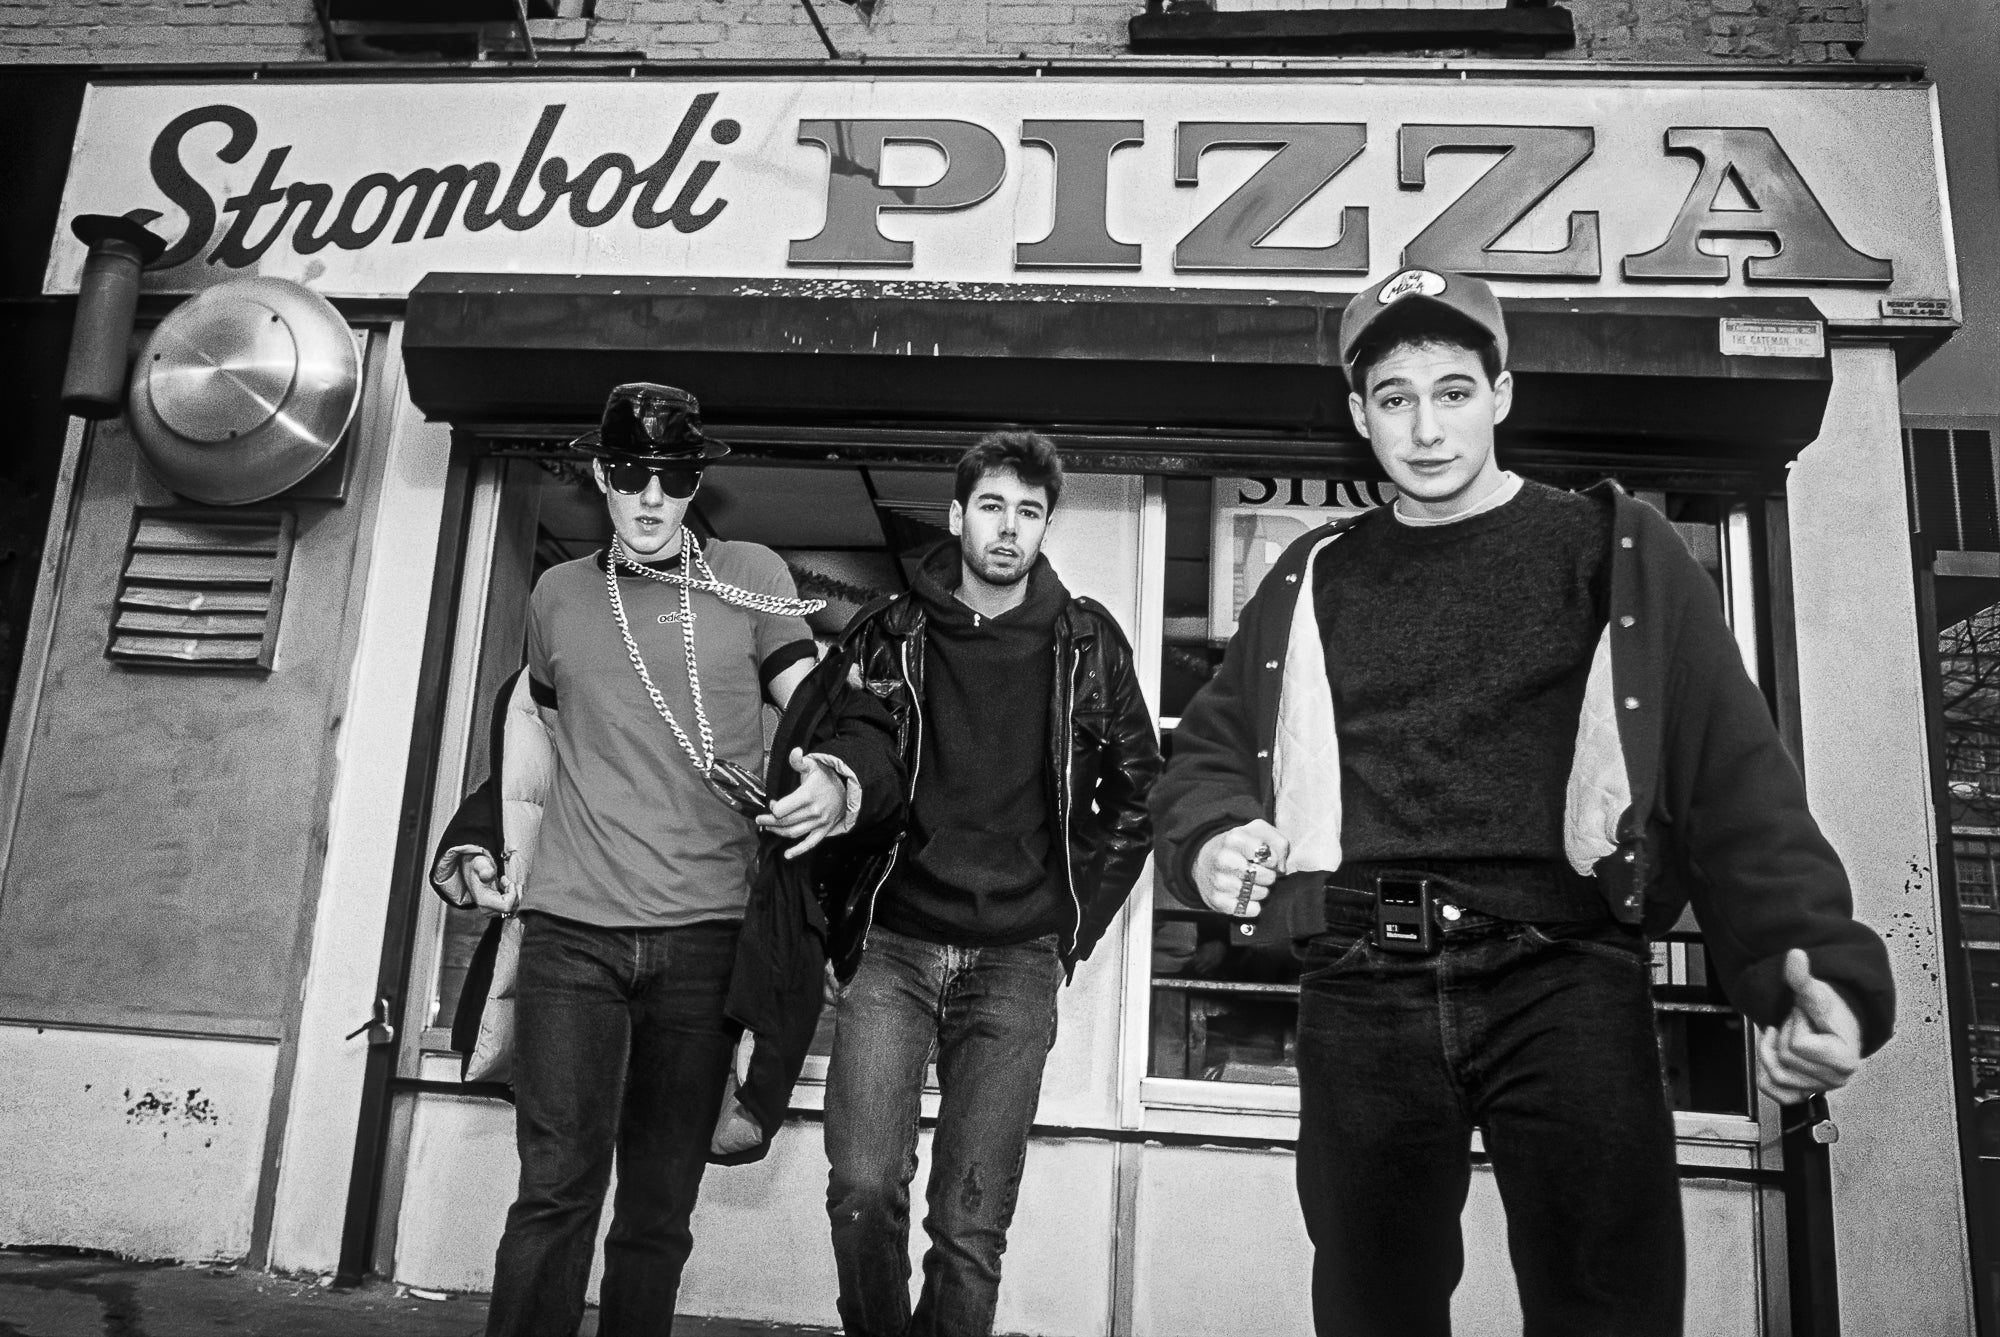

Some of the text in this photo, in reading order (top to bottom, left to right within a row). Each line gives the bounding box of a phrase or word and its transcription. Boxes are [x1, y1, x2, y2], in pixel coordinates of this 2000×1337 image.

[120, 91, 1894, 288] Stromboli PIZZA
[1732, 335, 1747, 345] THE
